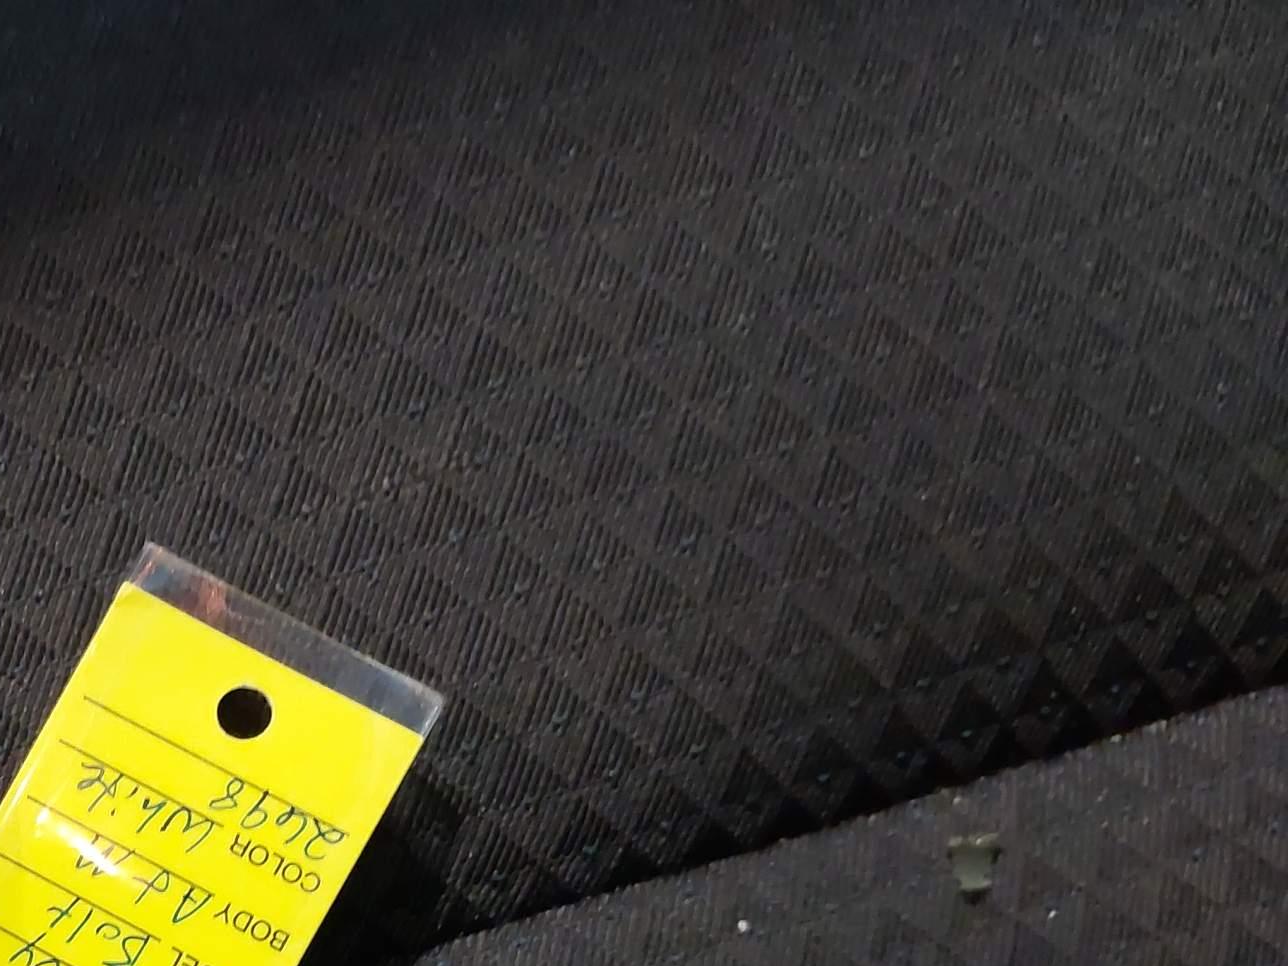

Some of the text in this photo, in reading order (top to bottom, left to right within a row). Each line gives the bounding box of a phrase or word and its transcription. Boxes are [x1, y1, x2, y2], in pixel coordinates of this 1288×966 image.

[76, 763, 320, 894] COLOR White
[208, 776, 344, 861] 2698
[212, 901, 290, 952] BODY
